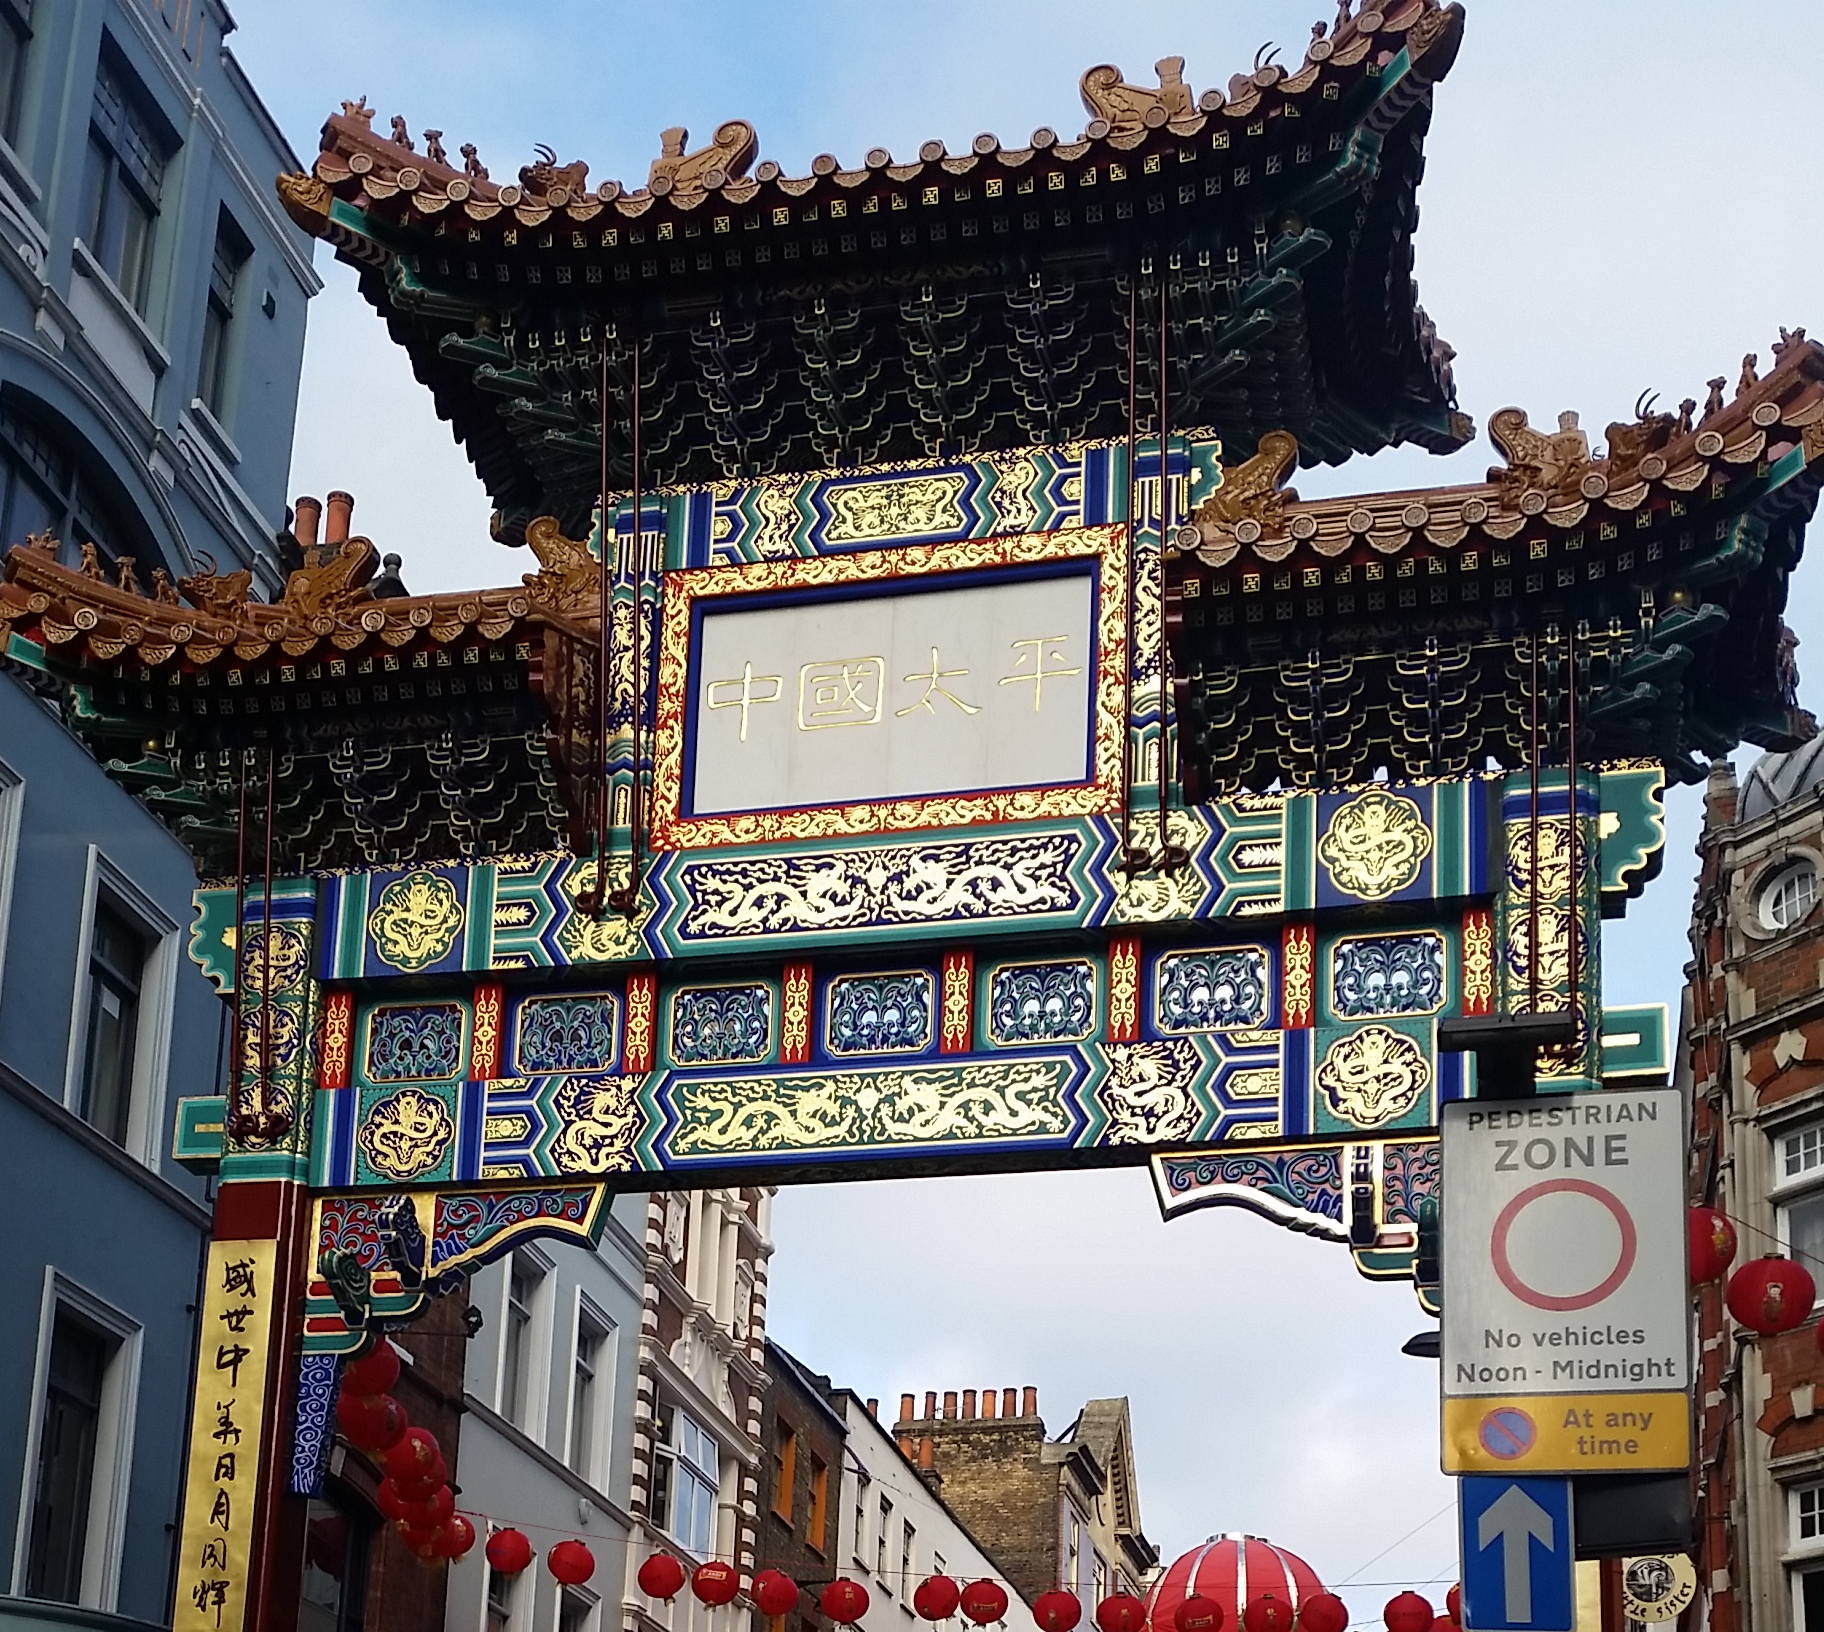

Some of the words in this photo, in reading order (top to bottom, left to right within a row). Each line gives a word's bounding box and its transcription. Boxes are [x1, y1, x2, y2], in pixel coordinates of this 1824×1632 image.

[706, 635, 1082, 743] 中國太平
[1467, 1101, 1658, 1132] PEDESTRIAN
[1495, 1134, 1630, 1172] ZONE
[1484, 1328, 1521, 1348] No
[1532, 1326, 1646, 1348] vehicles
[1456, 1363, 1527, 1383] Noon
[1552, 1357, 1677, 1383] Midnight
[1564, 1408, 1601, 1428] At
[1606, 1411, 1654, 1432] any
[1578, 1434, 1639, 1455] time
[1655, 1582, 1693, 1619] sister
